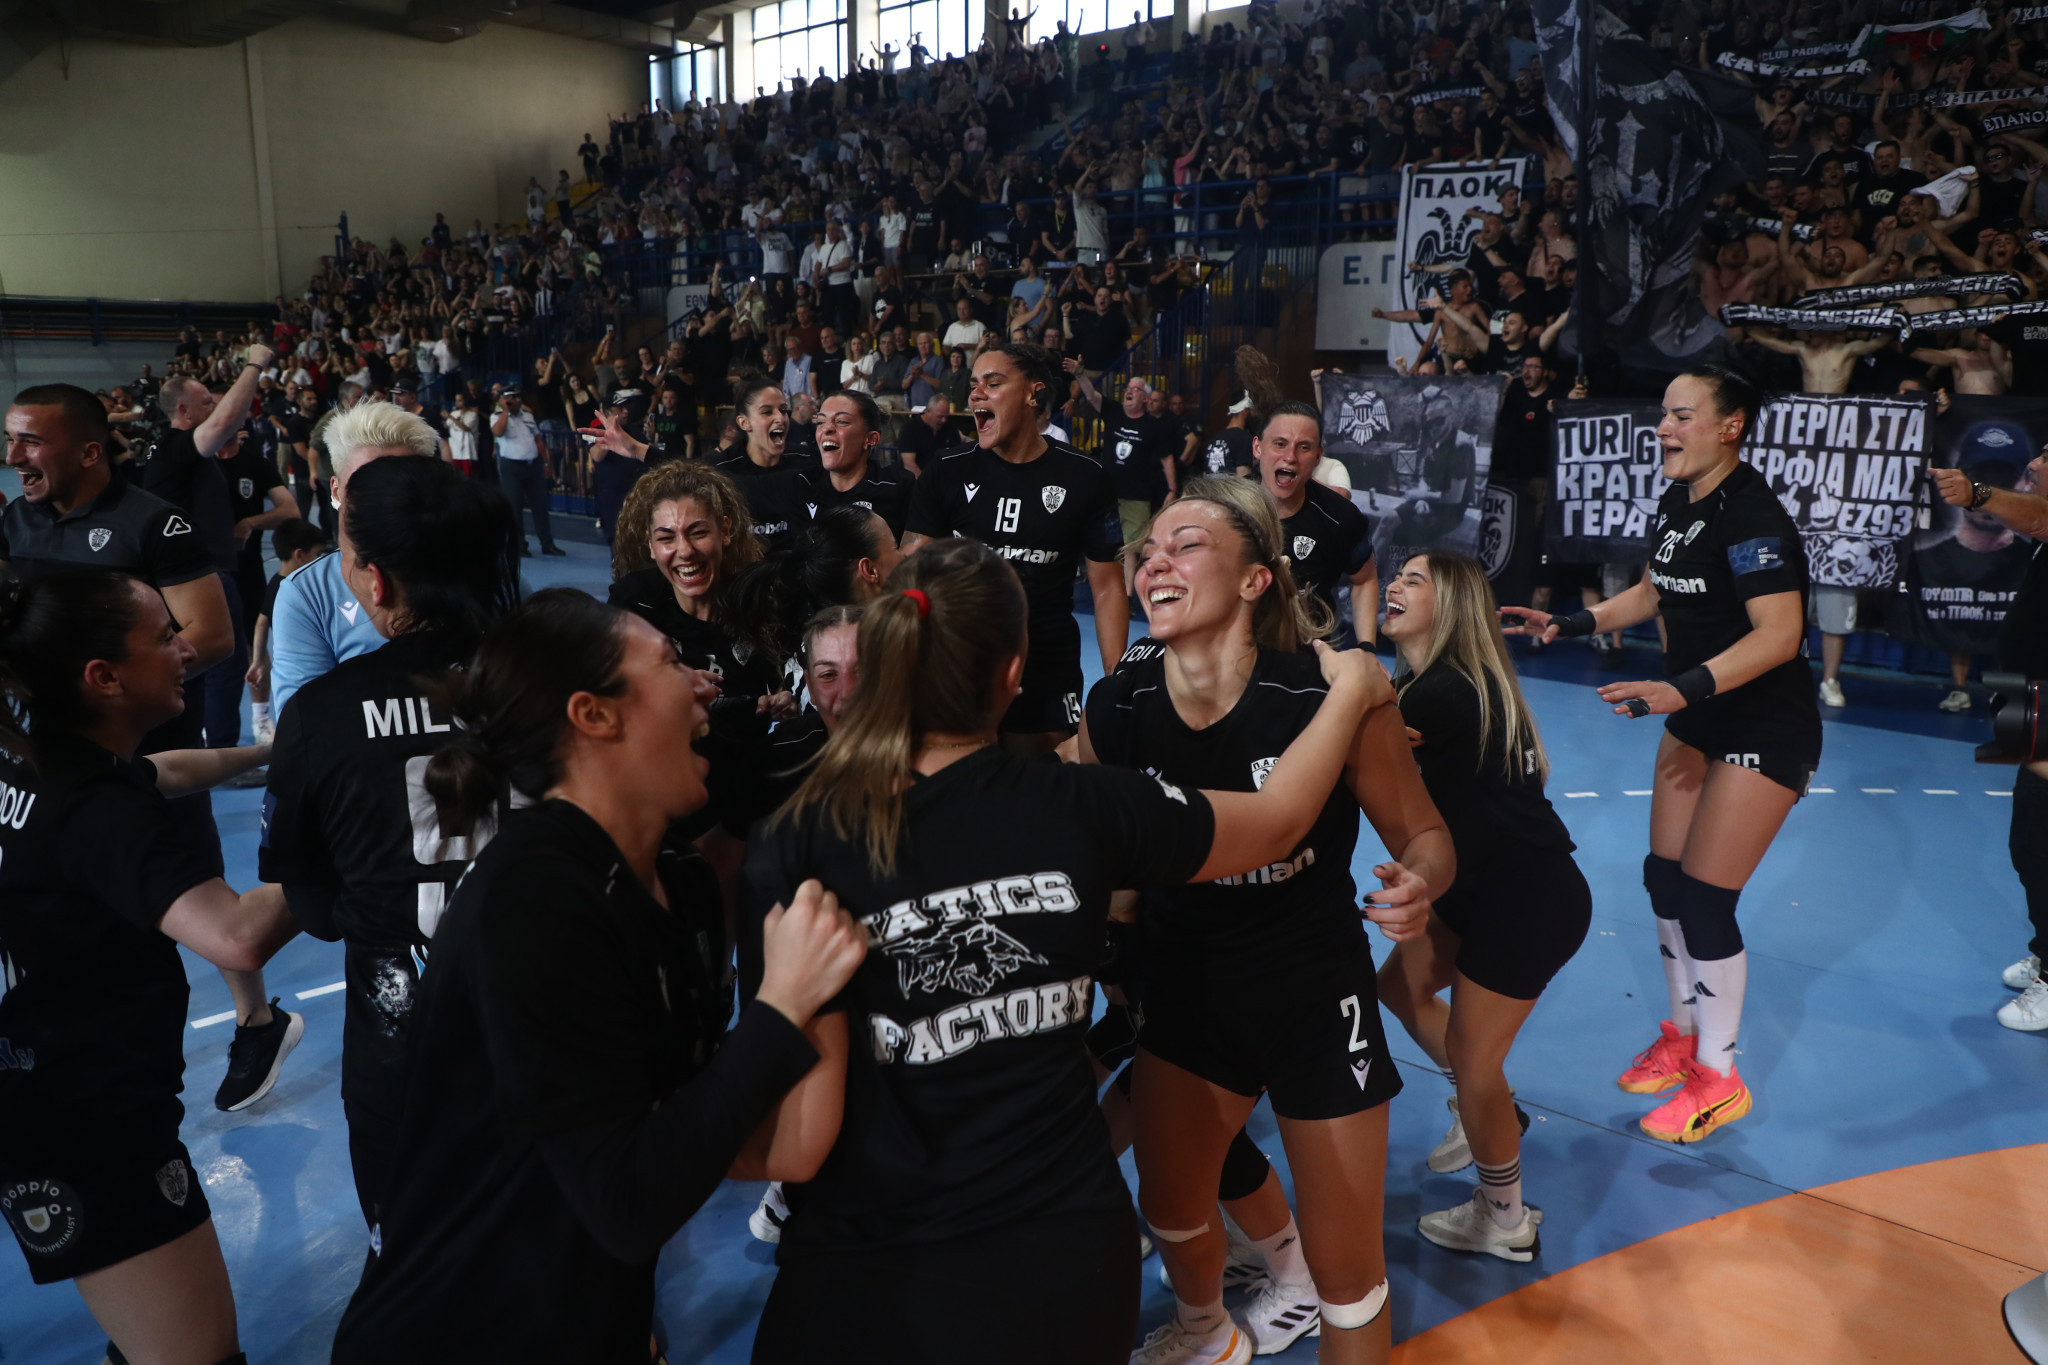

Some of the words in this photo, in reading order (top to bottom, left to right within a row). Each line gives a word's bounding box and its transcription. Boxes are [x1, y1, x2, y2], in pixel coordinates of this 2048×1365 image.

[1762, 49, 1790, 62] CLUB
[1747, 303, 1897, 327] ALEXANDRIA
[1558, 416, 1630, 459] TURI
[1746, 402, 1859, 449] ΥΤΕΡΙΑ
[1863, 406, 1926, 452] ΣΤΑ
[1851, 453, 1922, 502] ΜΑΣ
[995, 497, 1022, 533] 19
[1836, 501, 1915, 537] ΕΖ93
[1654, 526, 1685, 564] 26
[1946, 605, 1985, 620] ΠΑΟΚ
[362, 697, 467, 739] MIL
[868, 974, 1093, 1065] FACTORY
[1340, 995, 1369, 1053] 2
[2, 1179, 60, 1209] Doppio
